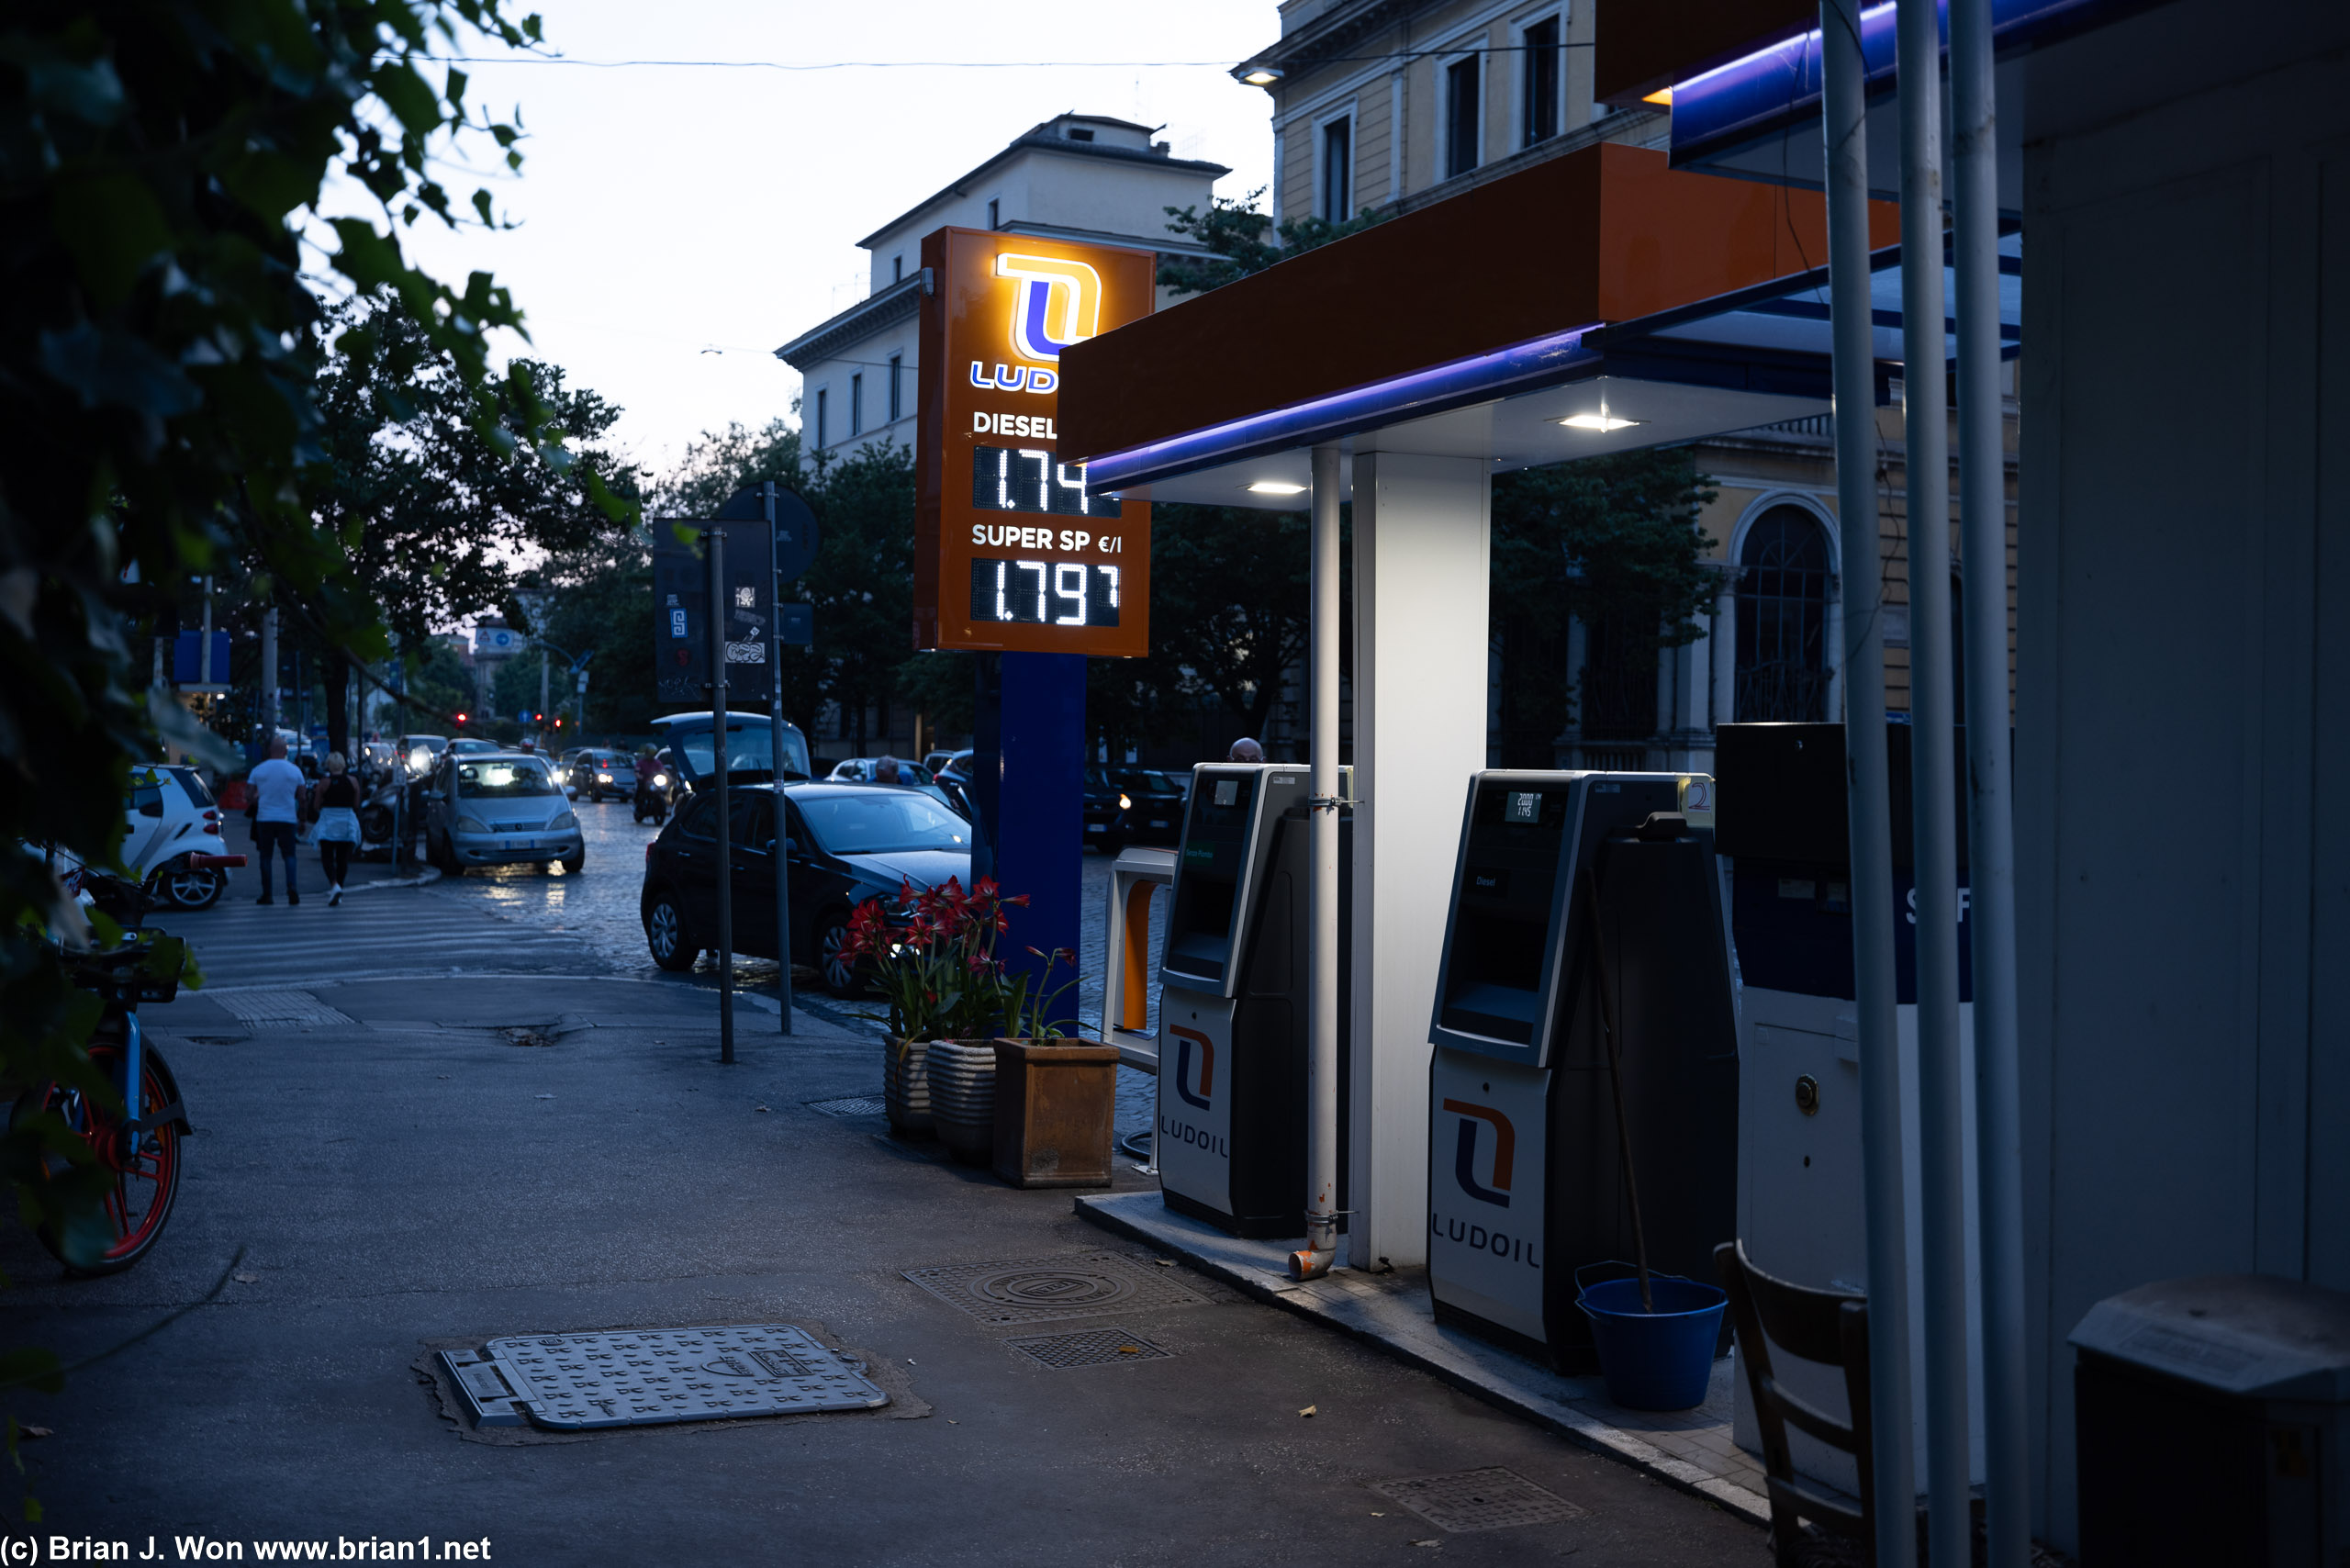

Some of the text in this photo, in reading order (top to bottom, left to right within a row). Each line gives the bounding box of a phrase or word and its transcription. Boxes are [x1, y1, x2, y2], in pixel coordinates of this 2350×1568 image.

[970, 361, 1058, 395] LUD
[973, 411, 1058, 440] DIESEL
[999, 450, 1089, 514] 1.74
[971, 524, 1053, 550] SUPER
[1059, 530, 1091, 552] SP
[1689, 782, 1710, 810] 2
[1476, 876, 1496, 887] Diesel
[1161, 1115, 1228, 1159] LUDOIL
[1432, 1213, 1540, 1269] LUDOIL
